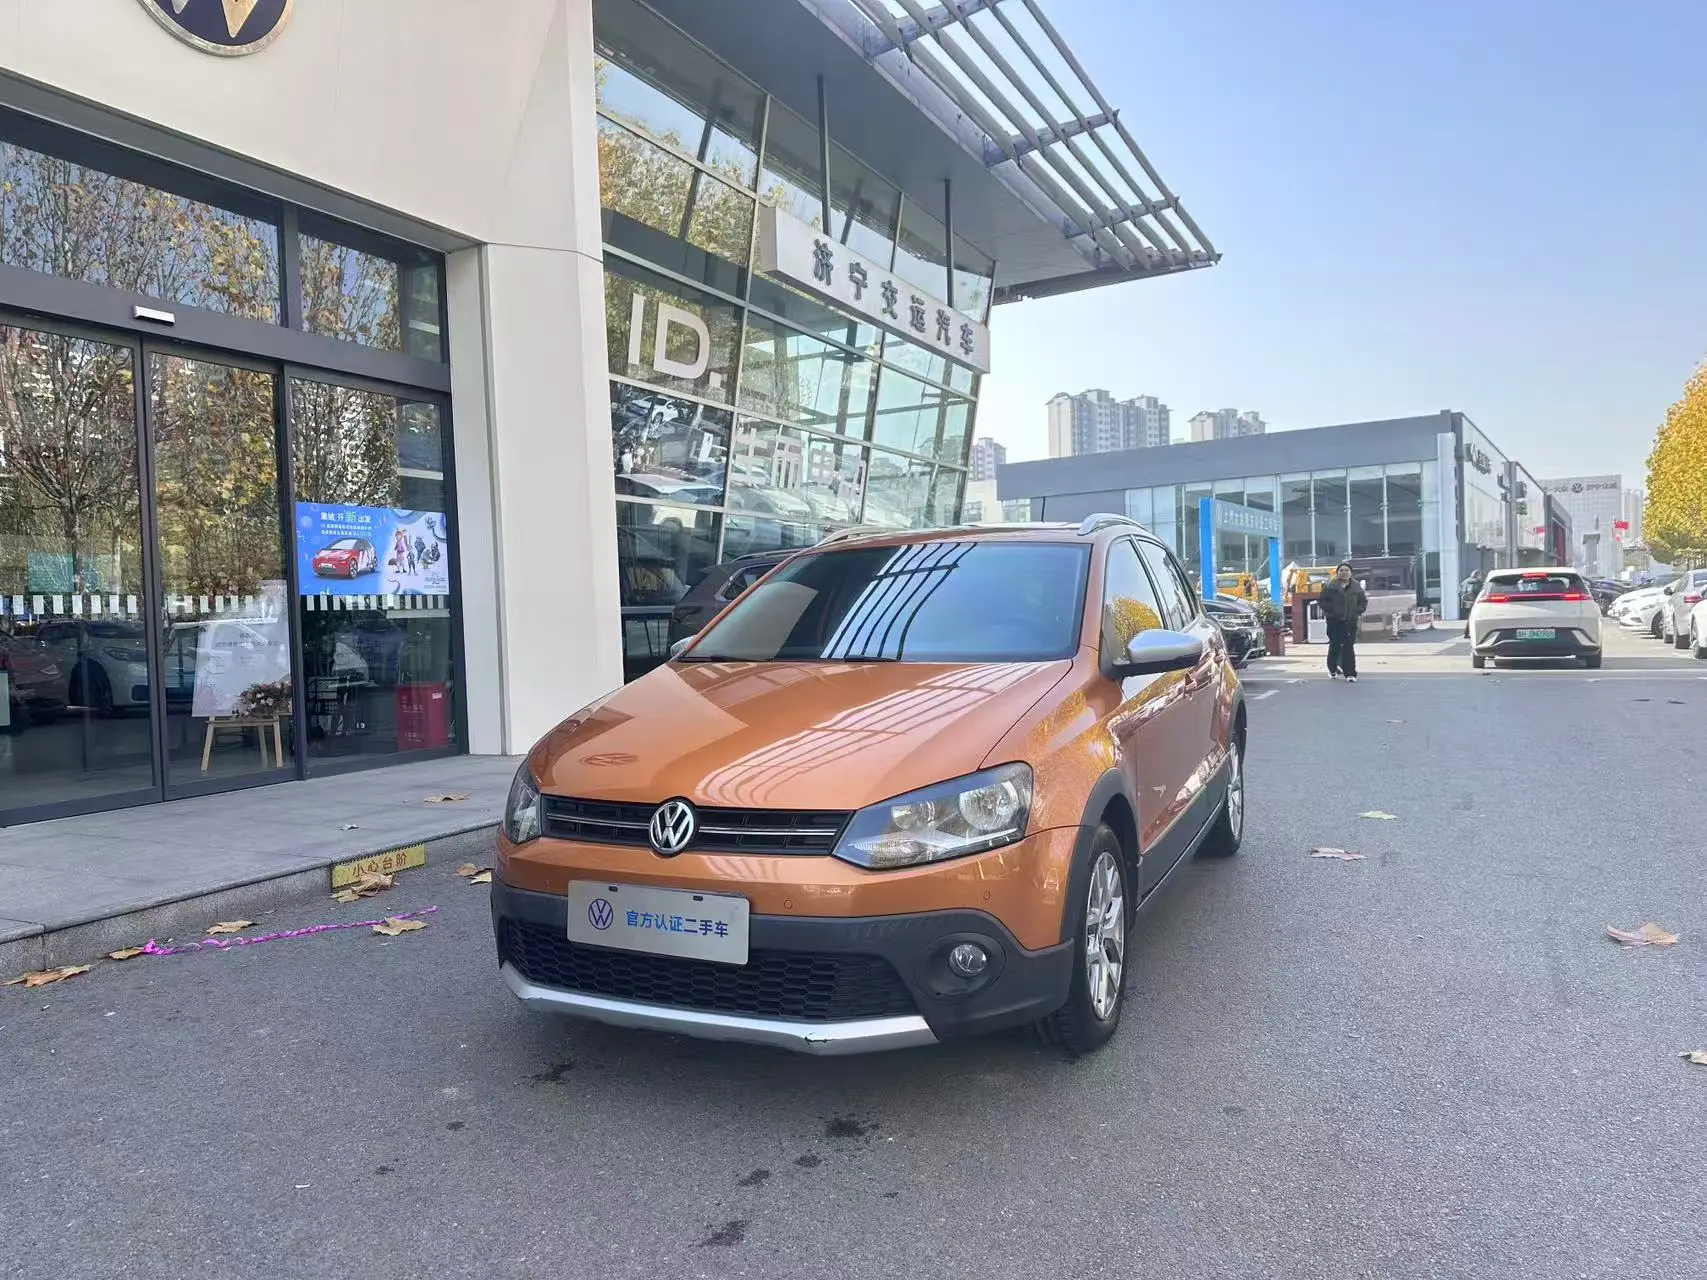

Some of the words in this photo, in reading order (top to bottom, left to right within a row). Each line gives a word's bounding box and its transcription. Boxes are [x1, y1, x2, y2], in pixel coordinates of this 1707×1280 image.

[813, 238, 974, 356] 济宁交运汽车
[628, 292, 722, 388] ID.
[352, 852, 408, 878] 小心台阶
[625, 910, 729, 938] 官方认证二手车
